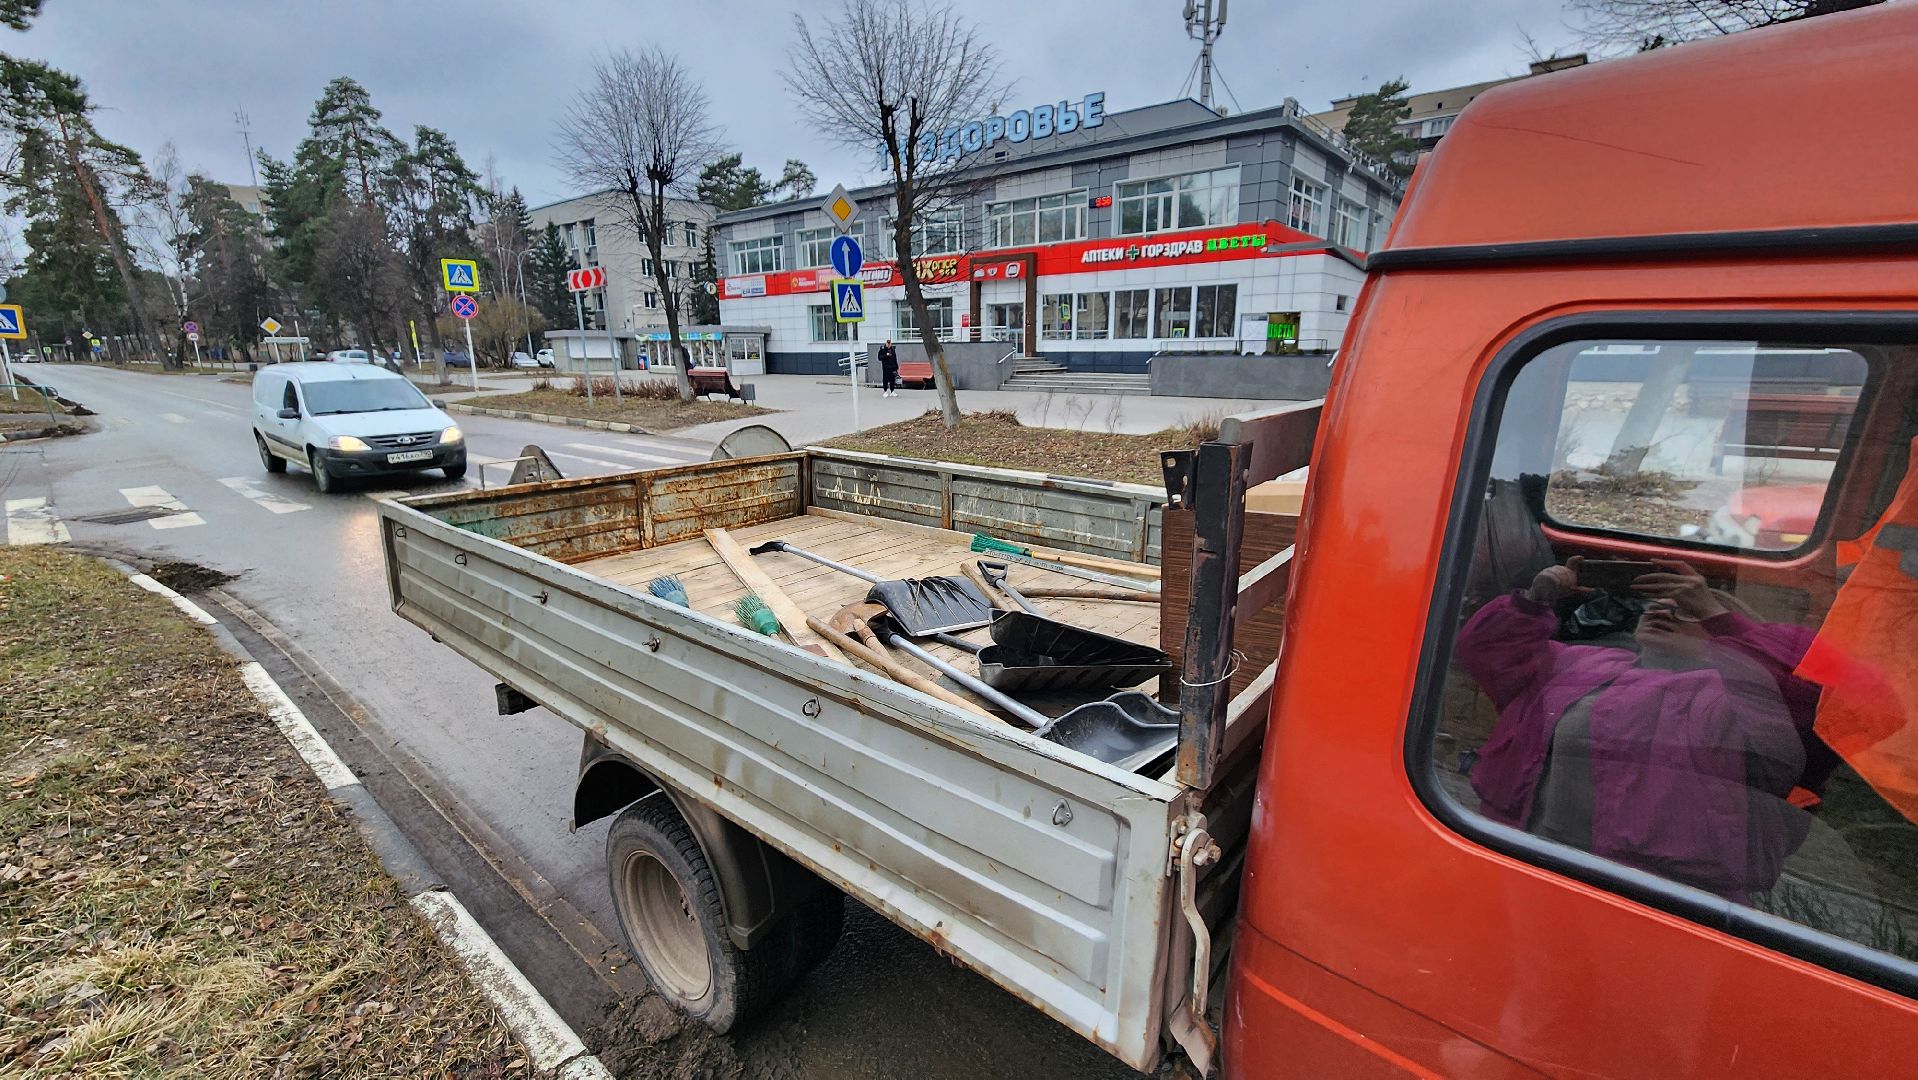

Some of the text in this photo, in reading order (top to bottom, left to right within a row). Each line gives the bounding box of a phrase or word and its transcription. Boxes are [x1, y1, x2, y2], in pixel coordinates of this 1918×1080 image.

[918, 91, 1106, 164] ЗДОРОВЬЕ
[1081, 239, 1204, 264] АПТЕКИ ГОРЗДРАВ
[1206, 234, 1266, 252] ЦВЕТЫ
